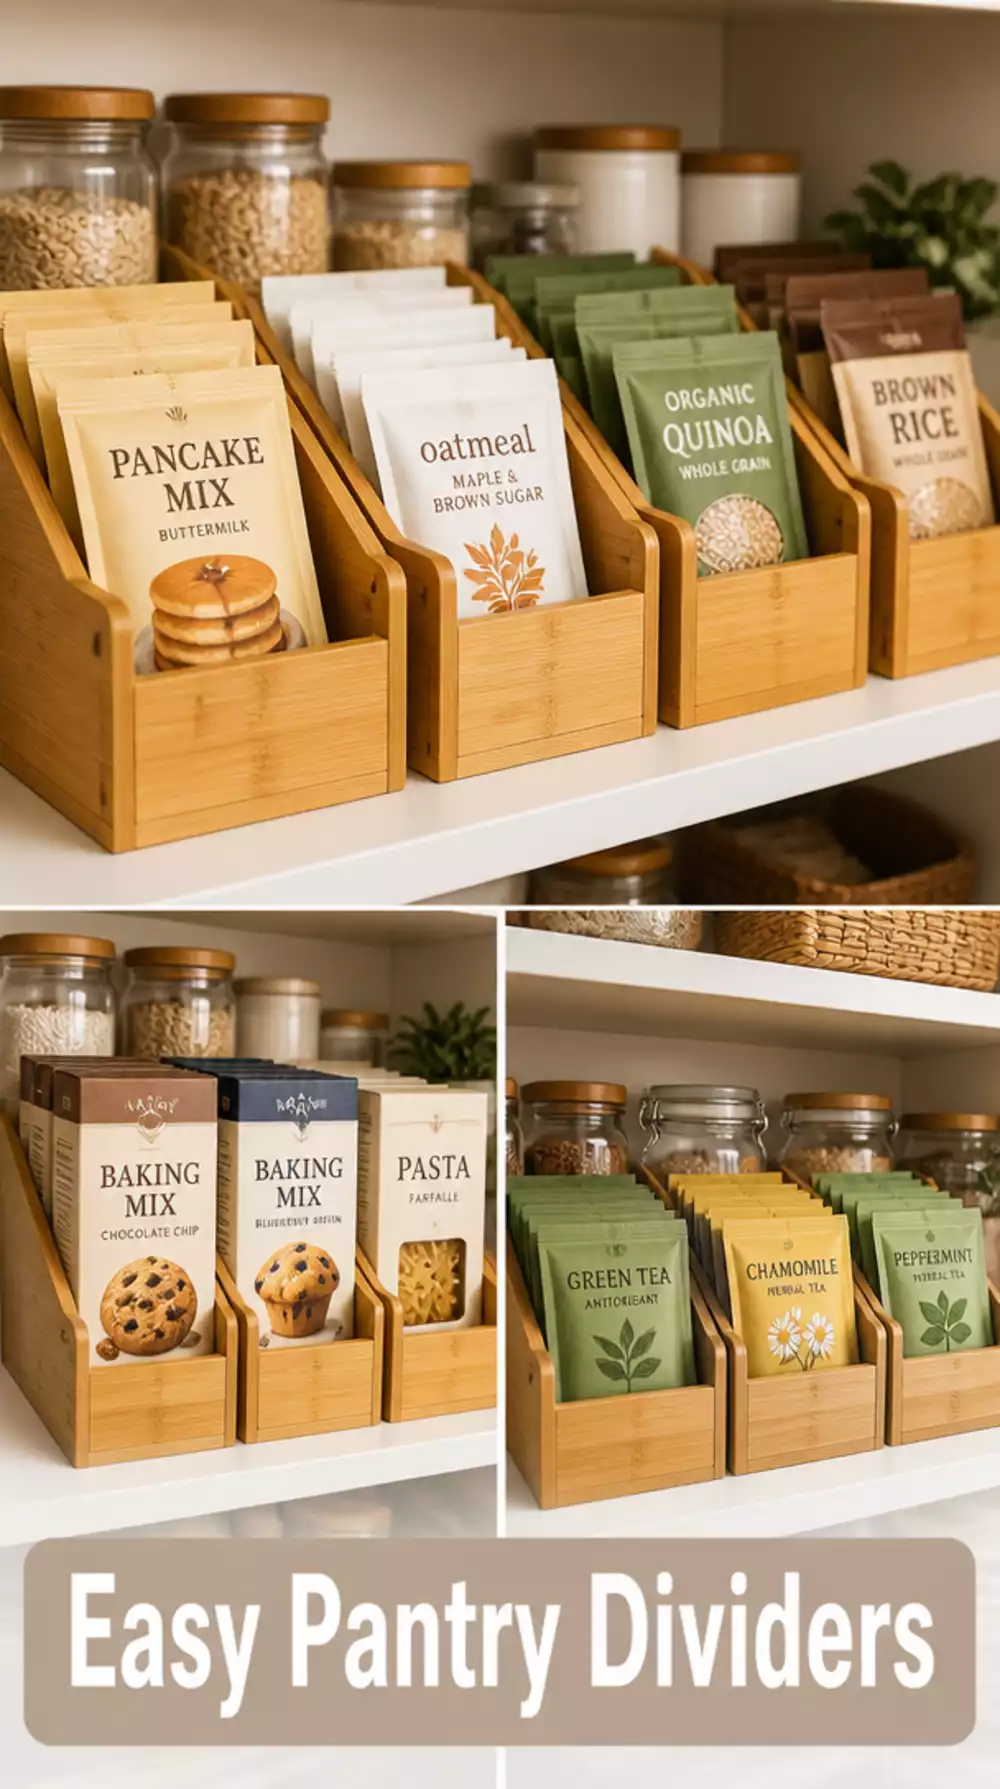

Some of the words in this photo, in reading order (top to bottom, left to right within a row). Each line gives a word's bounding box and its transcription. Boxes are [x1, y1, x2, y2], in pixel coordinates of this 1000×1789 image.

[664, 383, 755, 411] ORGANIC
[871, 374, 956, 406] BROWN
[663, 414, 773, 458] QUINOA
[889, 406, 959, 444] RICE
[420, 423, 537, 463] oatmeal
[109, 436, 264, 479] PANCAKE
[679, 460, 729, 480] WHOLE
[452, 470, 503, 489] MAPLE
[507, 468, 518, 484] &
[163, 477, 235, 513] MIX
[433, 493, 491, 513] BROWN
[495, 486, 544, 505] SUGAR
[158, 519, 250, 542] BUTTERMILK
[100, 1162, 200, 1188] BAKING
[254, 1157, 343, 1181] BAKING
[397, 1154, 471, 1181] PASTA
[124, 1193, 177, 1218] MIX
[276, 1185, 322, 1208] MIX
[101, 1227, 170, 1241] CHOCOLATE
[174, 1225, 200, 1237] CHIP
[567, 1268, 632, 1290] GREEN
[636, 1267, 672, 1286] TEA
[746, 1258, 839, 1281] CHAMOMILE
